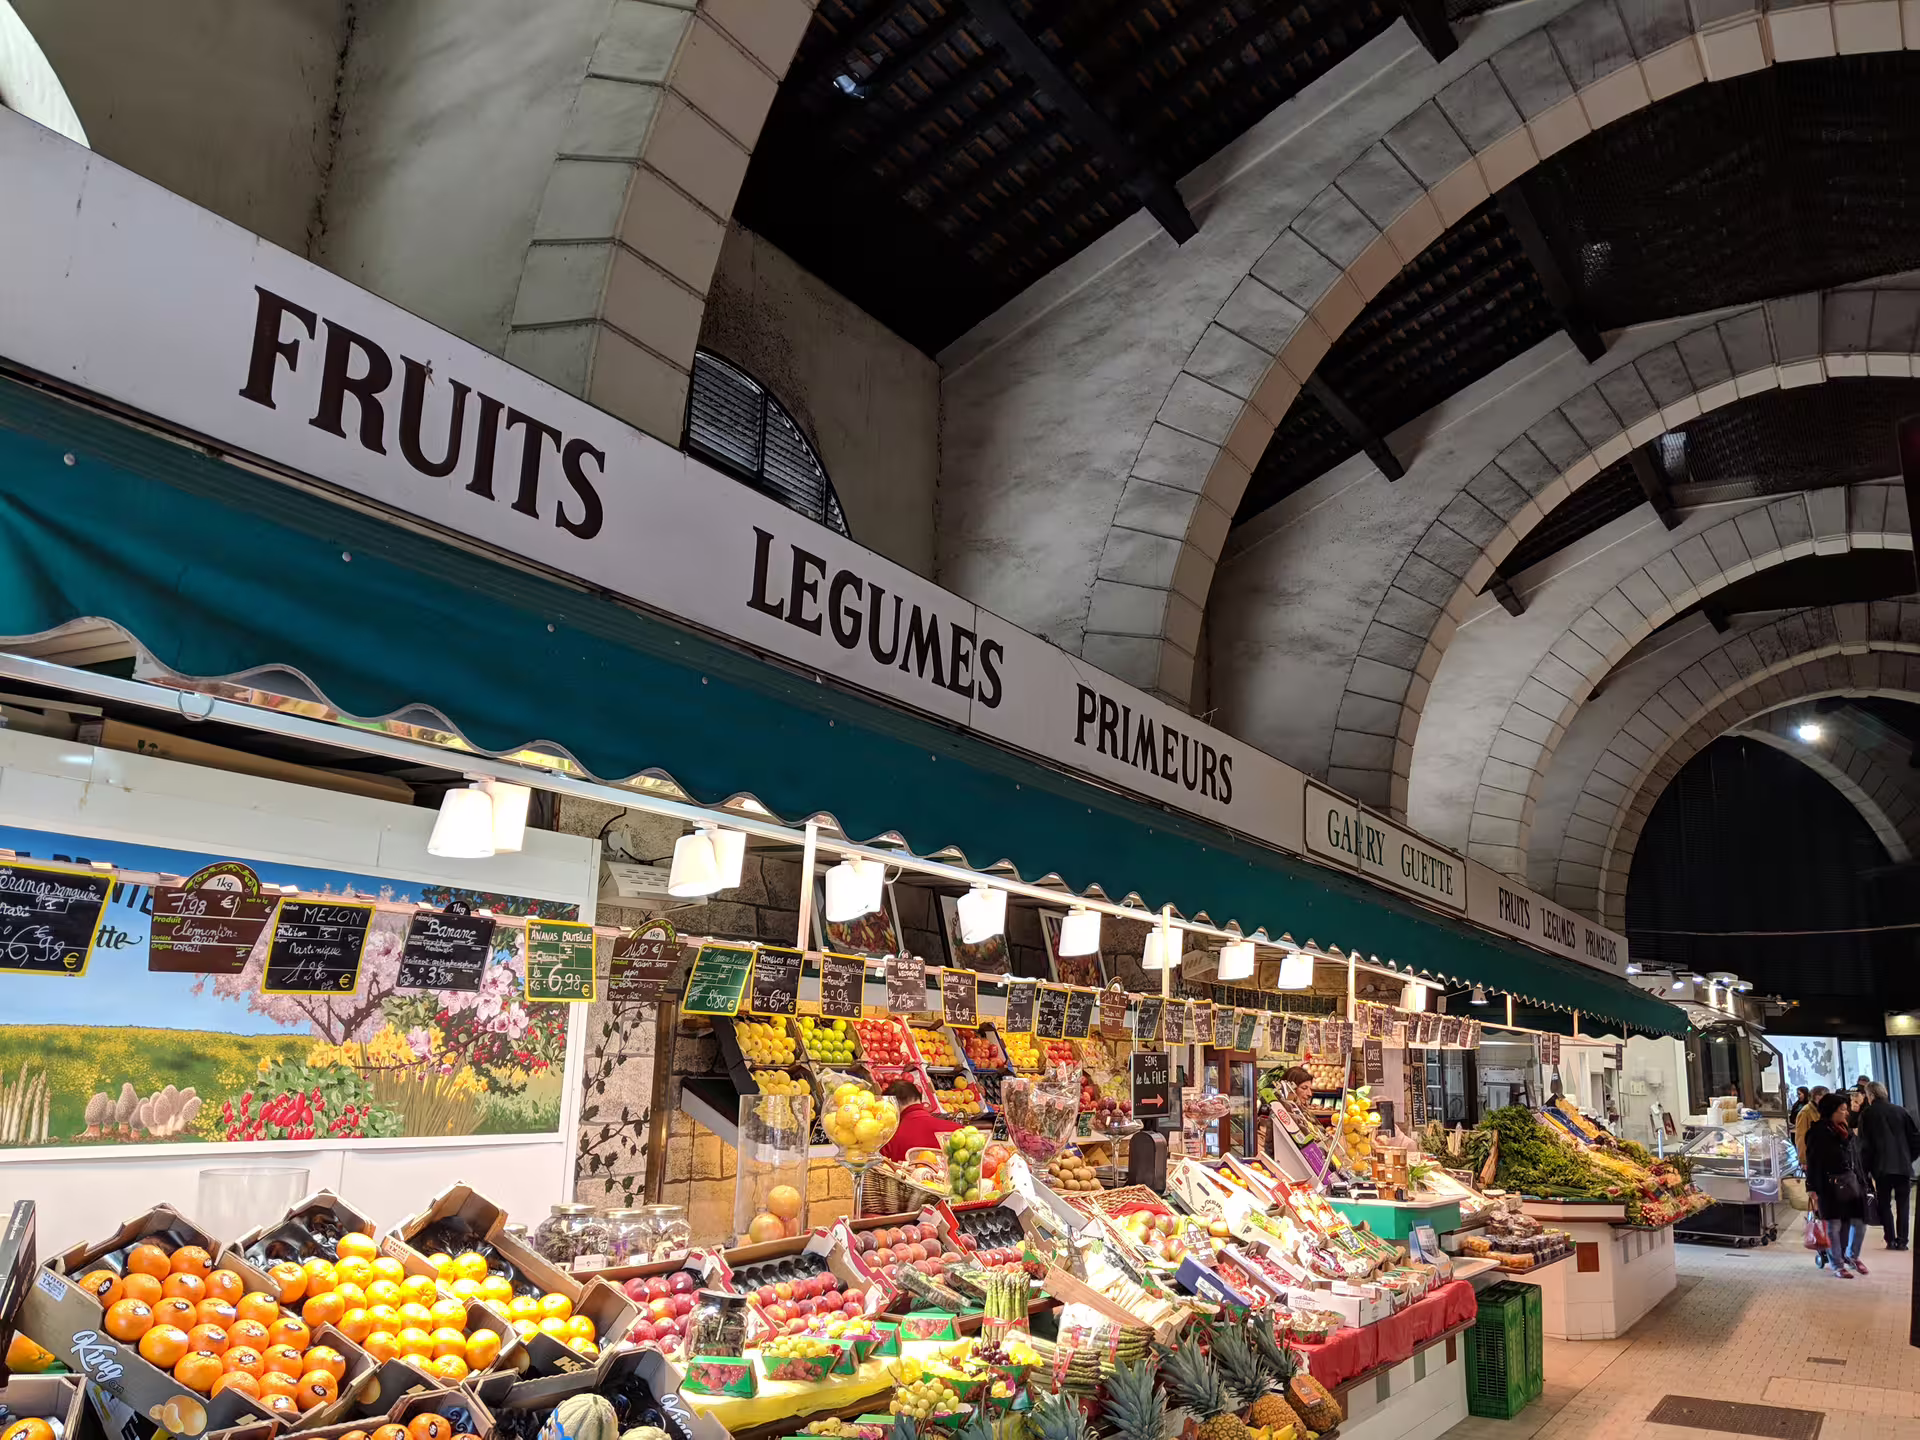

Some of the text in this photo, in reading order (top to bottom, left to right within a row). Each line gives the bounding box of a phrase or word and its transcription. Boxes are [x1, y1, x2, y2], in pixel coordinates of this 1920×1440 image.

[239, 285, 1232, 805] FRUITS LEGUMES PRIMEURS
[1327, 809, 1453, 896] GARRY GUETTE
[216, 878, 233, 890] 1kg
[303, 907, 362, 924] MELON
[452, 903, 466, 915] 1kg
[424, 919, 477, 939] Banane
[1499, 886, 1617, 965] FRUITS LEGUMES PRIMEURS
[531, 930, 592, 942] ANANAS BOUTEILLE
[63, 952, 80, 969] €
[760, 955, 784, 964] POMELOS
[786, 958, 800, 966] ROSE
[339, 974, 351, 988] €
[582, 984, 590, 996] €
[1145, 1056, 1157, 1066] SENS
[1152, 1068, 1167, 1084] FILE
[70, 1330, 124, 1382] King
